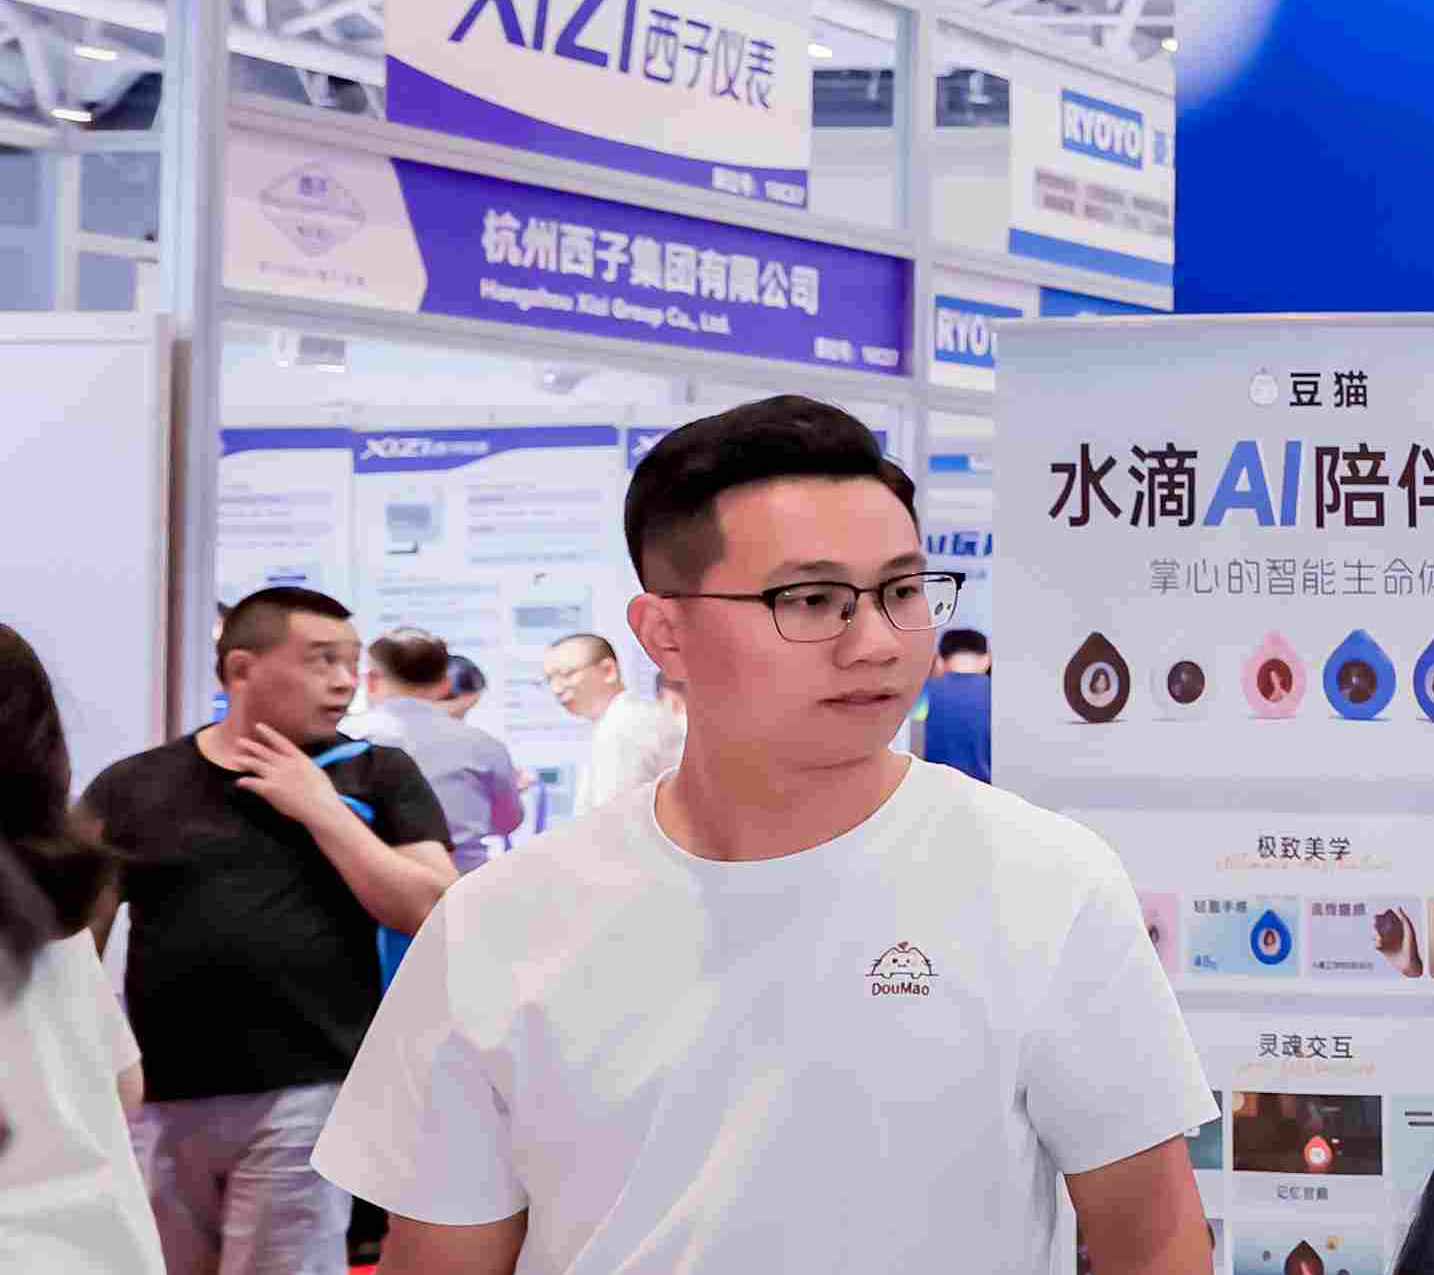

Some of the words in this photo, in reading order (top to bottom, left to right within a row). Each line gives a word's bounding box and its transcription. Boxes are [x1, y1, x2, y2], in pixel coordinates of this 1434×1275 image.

[643, 8, 776, 110] 西子仪表
[1063, 100, 1142, 159] RYOYO
[482, 209, 818, 315] 杭州西子集团有限公司
[936, 306, 997, 357] RYO
[1289, 370, 1368, 408] 豆猫
[1258, 836, 1351, 861] 极致美学
[871, 982, 930, 997] DouMao
[1258, 1035, 1353, 1059] 灵魂交互
